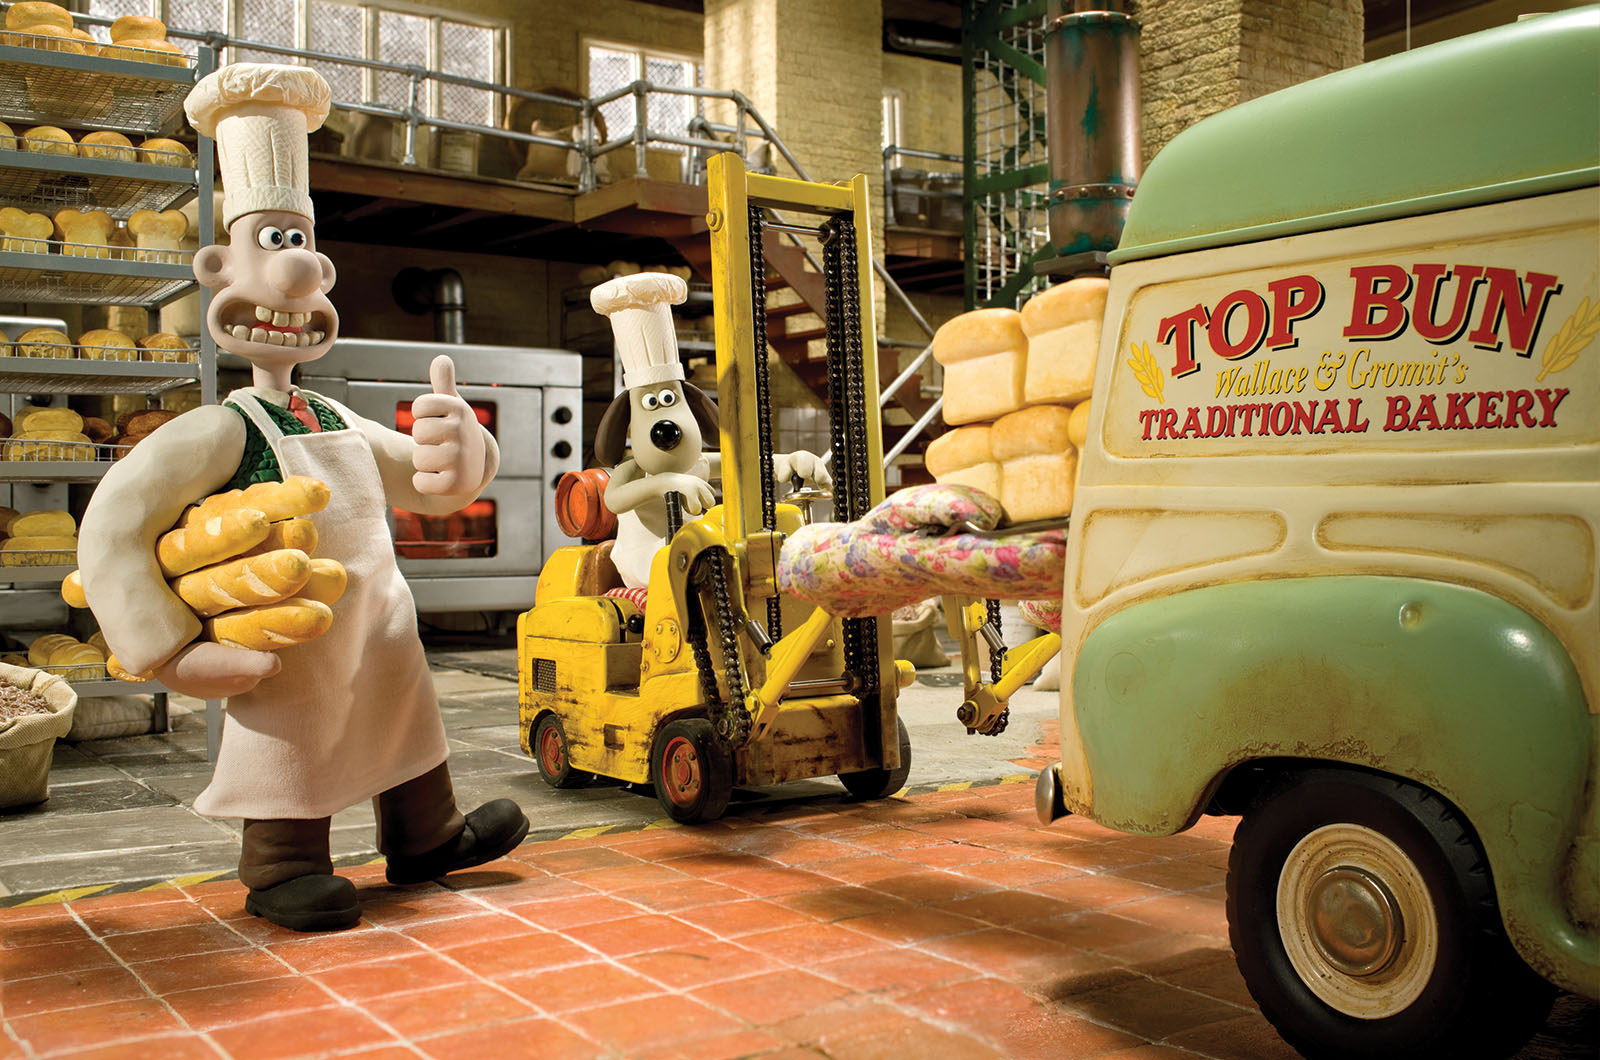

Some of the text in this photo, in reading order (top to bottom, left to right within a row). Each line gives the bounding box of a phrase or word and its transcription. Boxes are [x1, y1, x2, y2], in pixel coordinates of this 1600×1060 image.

[1157, 264, 1564, 379] TOP BUN
[1214, 348, 1470, 399] Wallace & Gromit's
[1139, 388, 1570, 441] TRADITIONAL BAKERY
